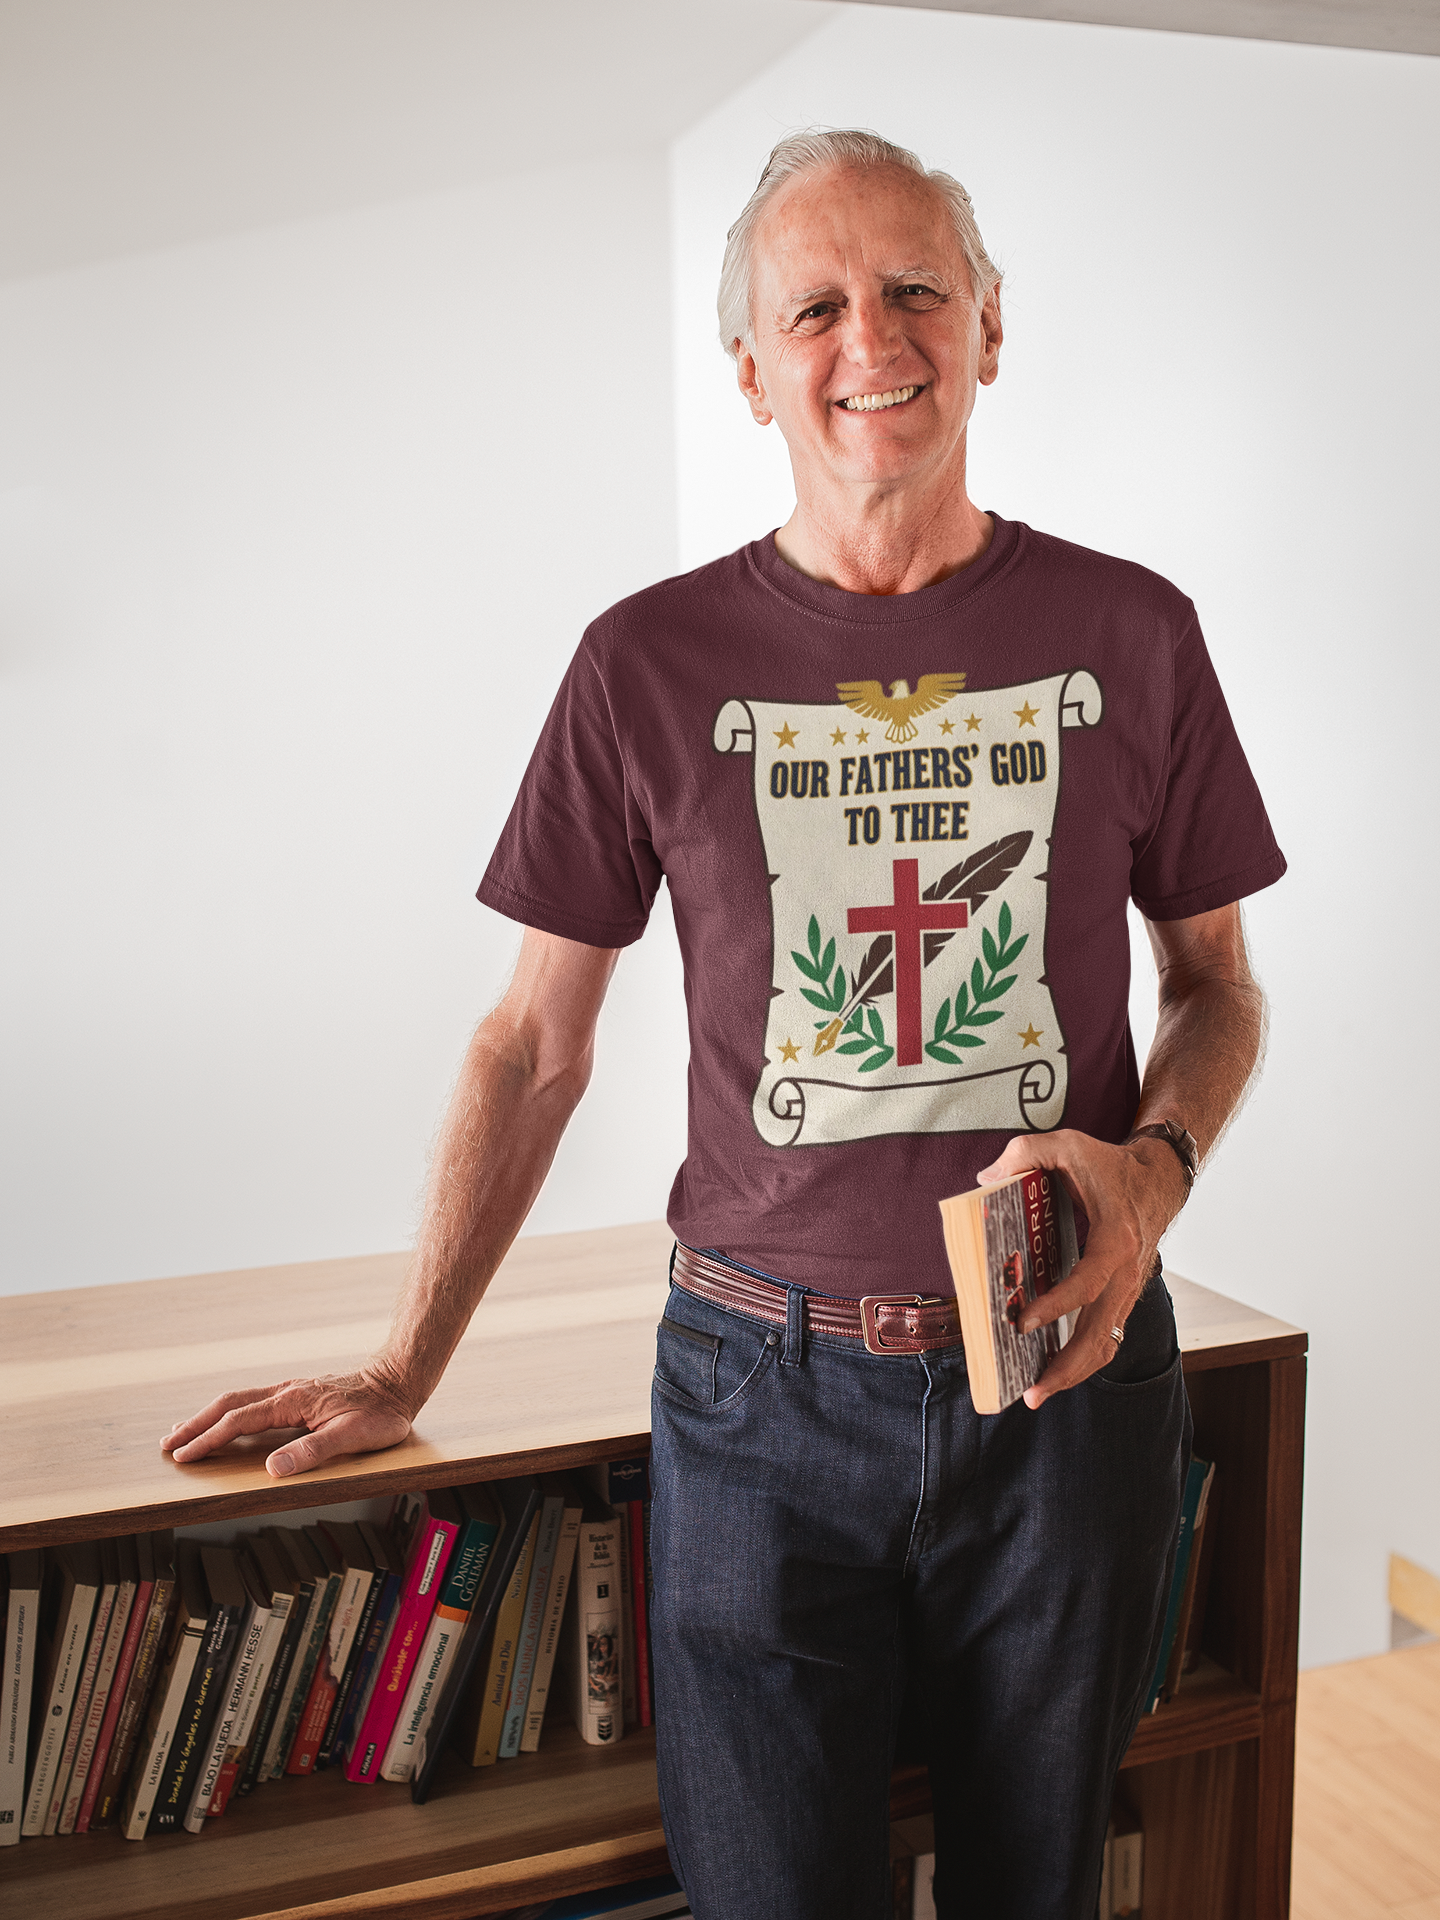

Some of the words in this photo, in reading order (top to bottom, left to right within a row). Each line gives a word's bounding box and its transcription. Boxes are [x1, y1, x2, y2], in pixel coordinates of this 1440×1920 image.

[769, 760, 830, 799] OUR
[989, 740, 1047, 786] GOD
[844, 805, 881, 846] TO
[890, 801, 970, 843] THEE
[1028, 1180, 1045, 1277] DORIS
[1040, 1176, 1060, 1283] ESSING
[451, 1544, 479, 1588] DANIEL
[457, 1541, 491, 1603] GOLEMAN
[527, 1564, 549, 1629] PARPADEA
[554, 1575, 566, 1603] CRISTO
[552, 1606, 560, 1615] DE
[243, 1623, 263, 1660] HESSE
[499, 1639, 512, 1659] Dios
[544, 1619, 558, 1654] HISTORIA
[425, 1632, 451, 1680] emocional
[499, 1660, 508, 1673] con
[519, 1632, 537, 1675] NUNCA
[194, 1665, 214, 1706] duermen
[227, 1662, 251, 1712] HERMANN
[491, 1674, 506, 1706] Amistad
[514, 1677, 528, 1706] DIOS
[192, 1707, 203, 1721] no
[407, 1680, 436, 1733] inteligencia
[74, 1738, 95, 1780] DIEGO
[87, 1689, 107, 1729] FRIDA
[215, 1718, 233, 1753] RUEDA
[403, 1732, 416, 1746] La
[151, 1750, 165, 1775] ILIADA
[174, 1758, 188, 1774] los
[210, 1754, 222, 1768] LA
[361, 1743, 376, 1775] AGUILAR
[148, 1775, 157, 1786] LA
[167, 1774, 184, 1805] Donde
[201, 1769, 218, 1797] BAJO
[29, 1800, 41, 1824] JORGE
